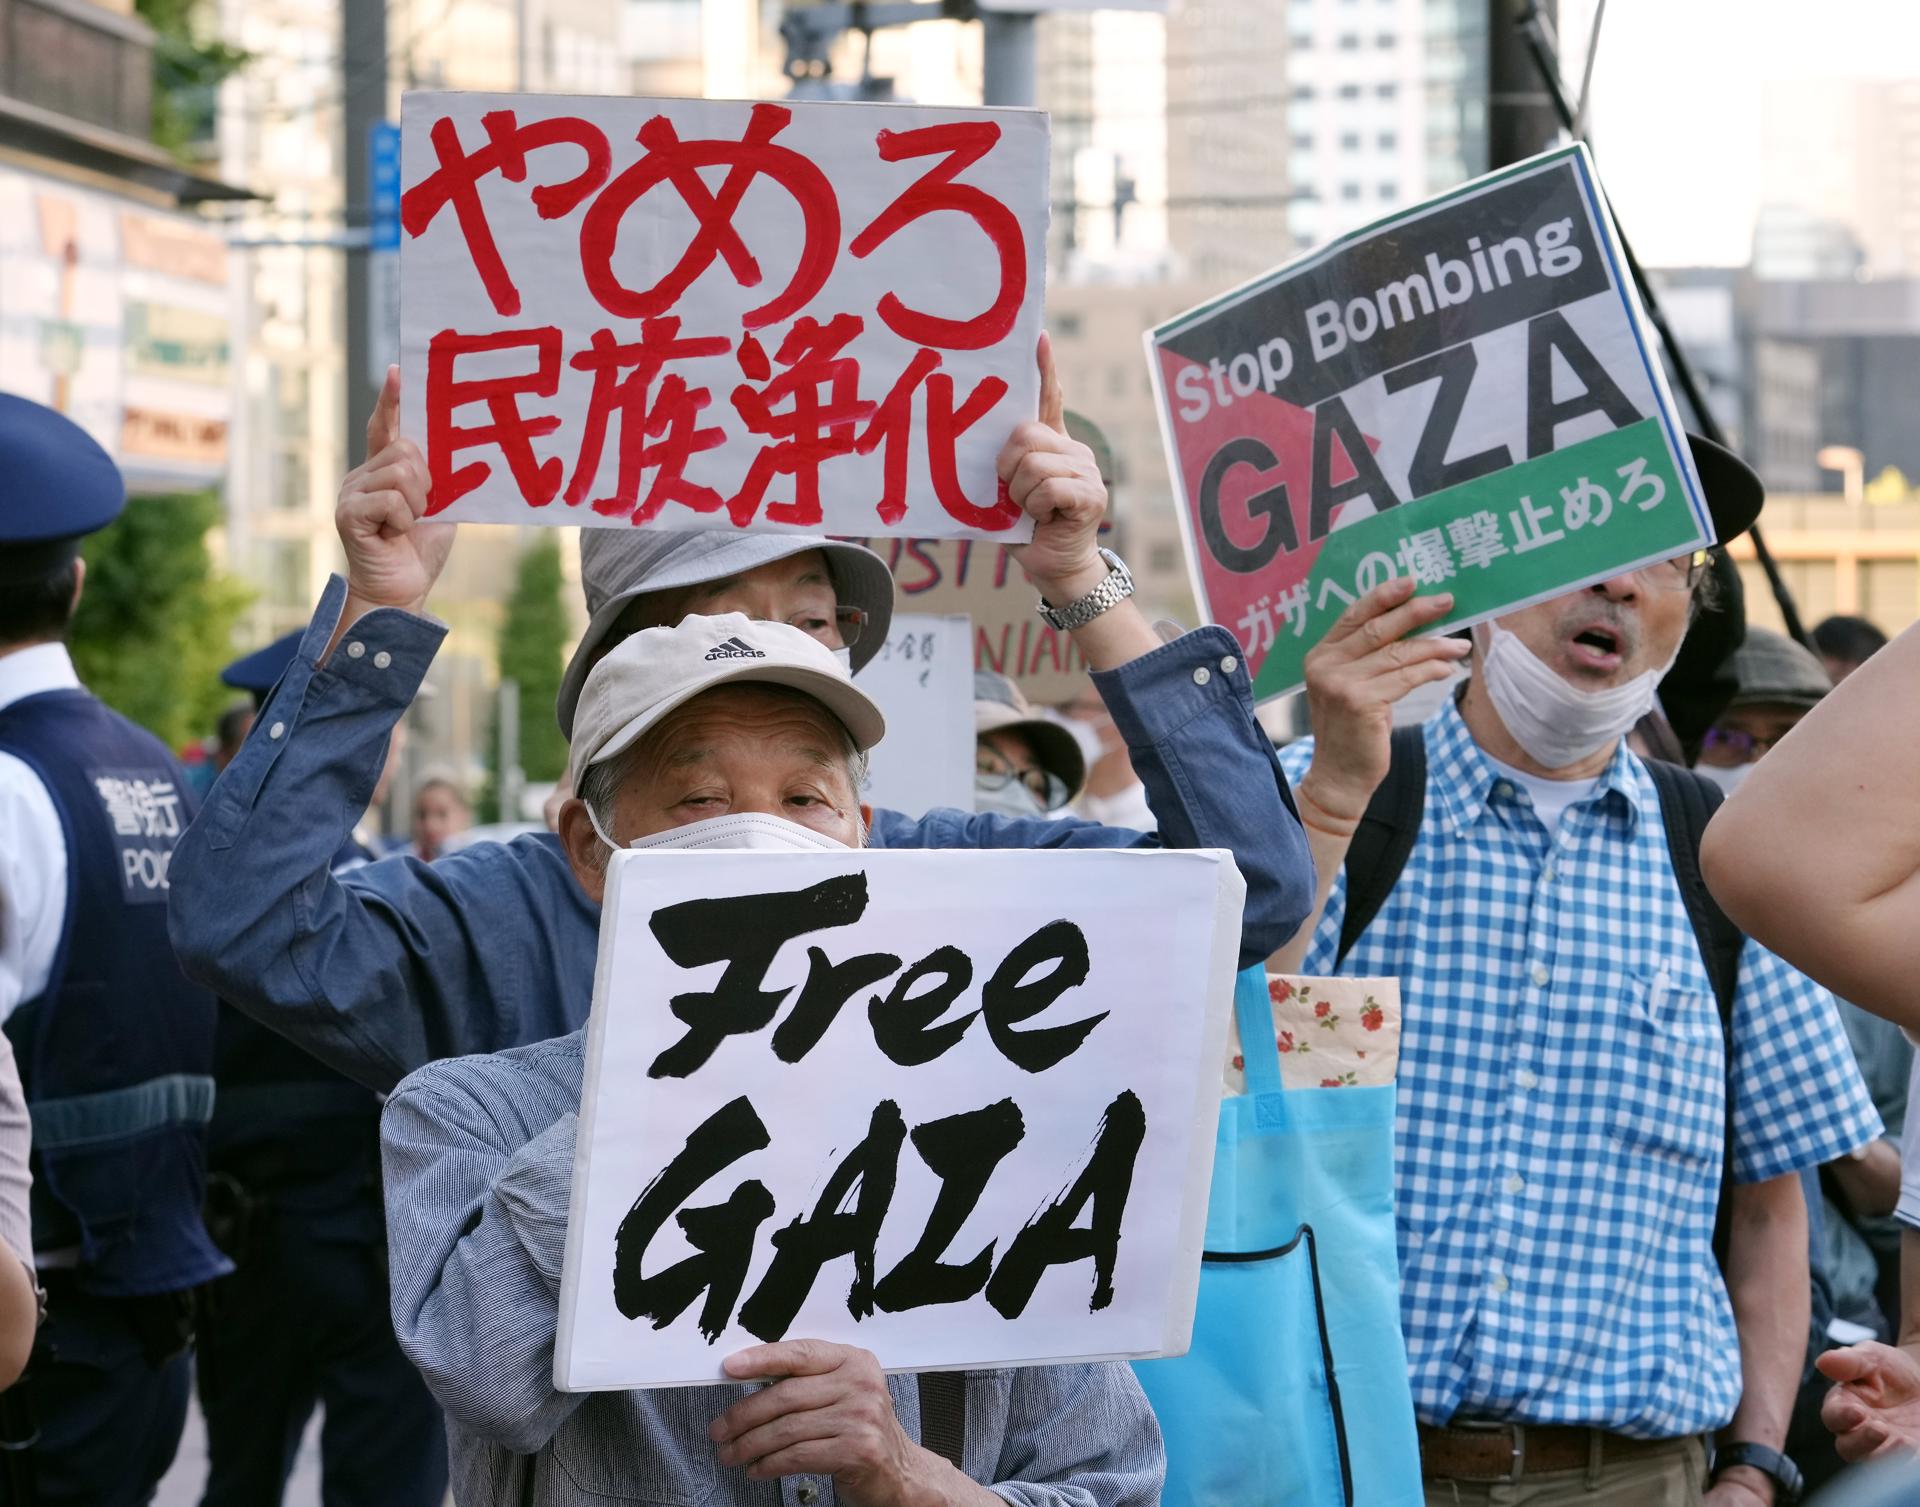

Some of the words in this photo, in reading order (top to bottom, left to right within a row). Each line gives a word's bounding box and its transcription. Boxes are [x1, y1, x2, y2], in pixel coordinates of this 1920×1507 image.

[401, 104, 1027, 350] やめろ
[1174, 335, 1294, 423] Stop
[1305, 217, 1583, 364] Bombing
[423, 314, 1023, 531] 民族浄化
[1200, 310, 1645, 574] GAZA
[704, 650, 766, 661] adidas
[1237, 457, 1666, 658] ガザへの爆撃止めろ
[647, 870, 1111, 1079] Free
[613, 1088, 1146, 1346] GAZA
